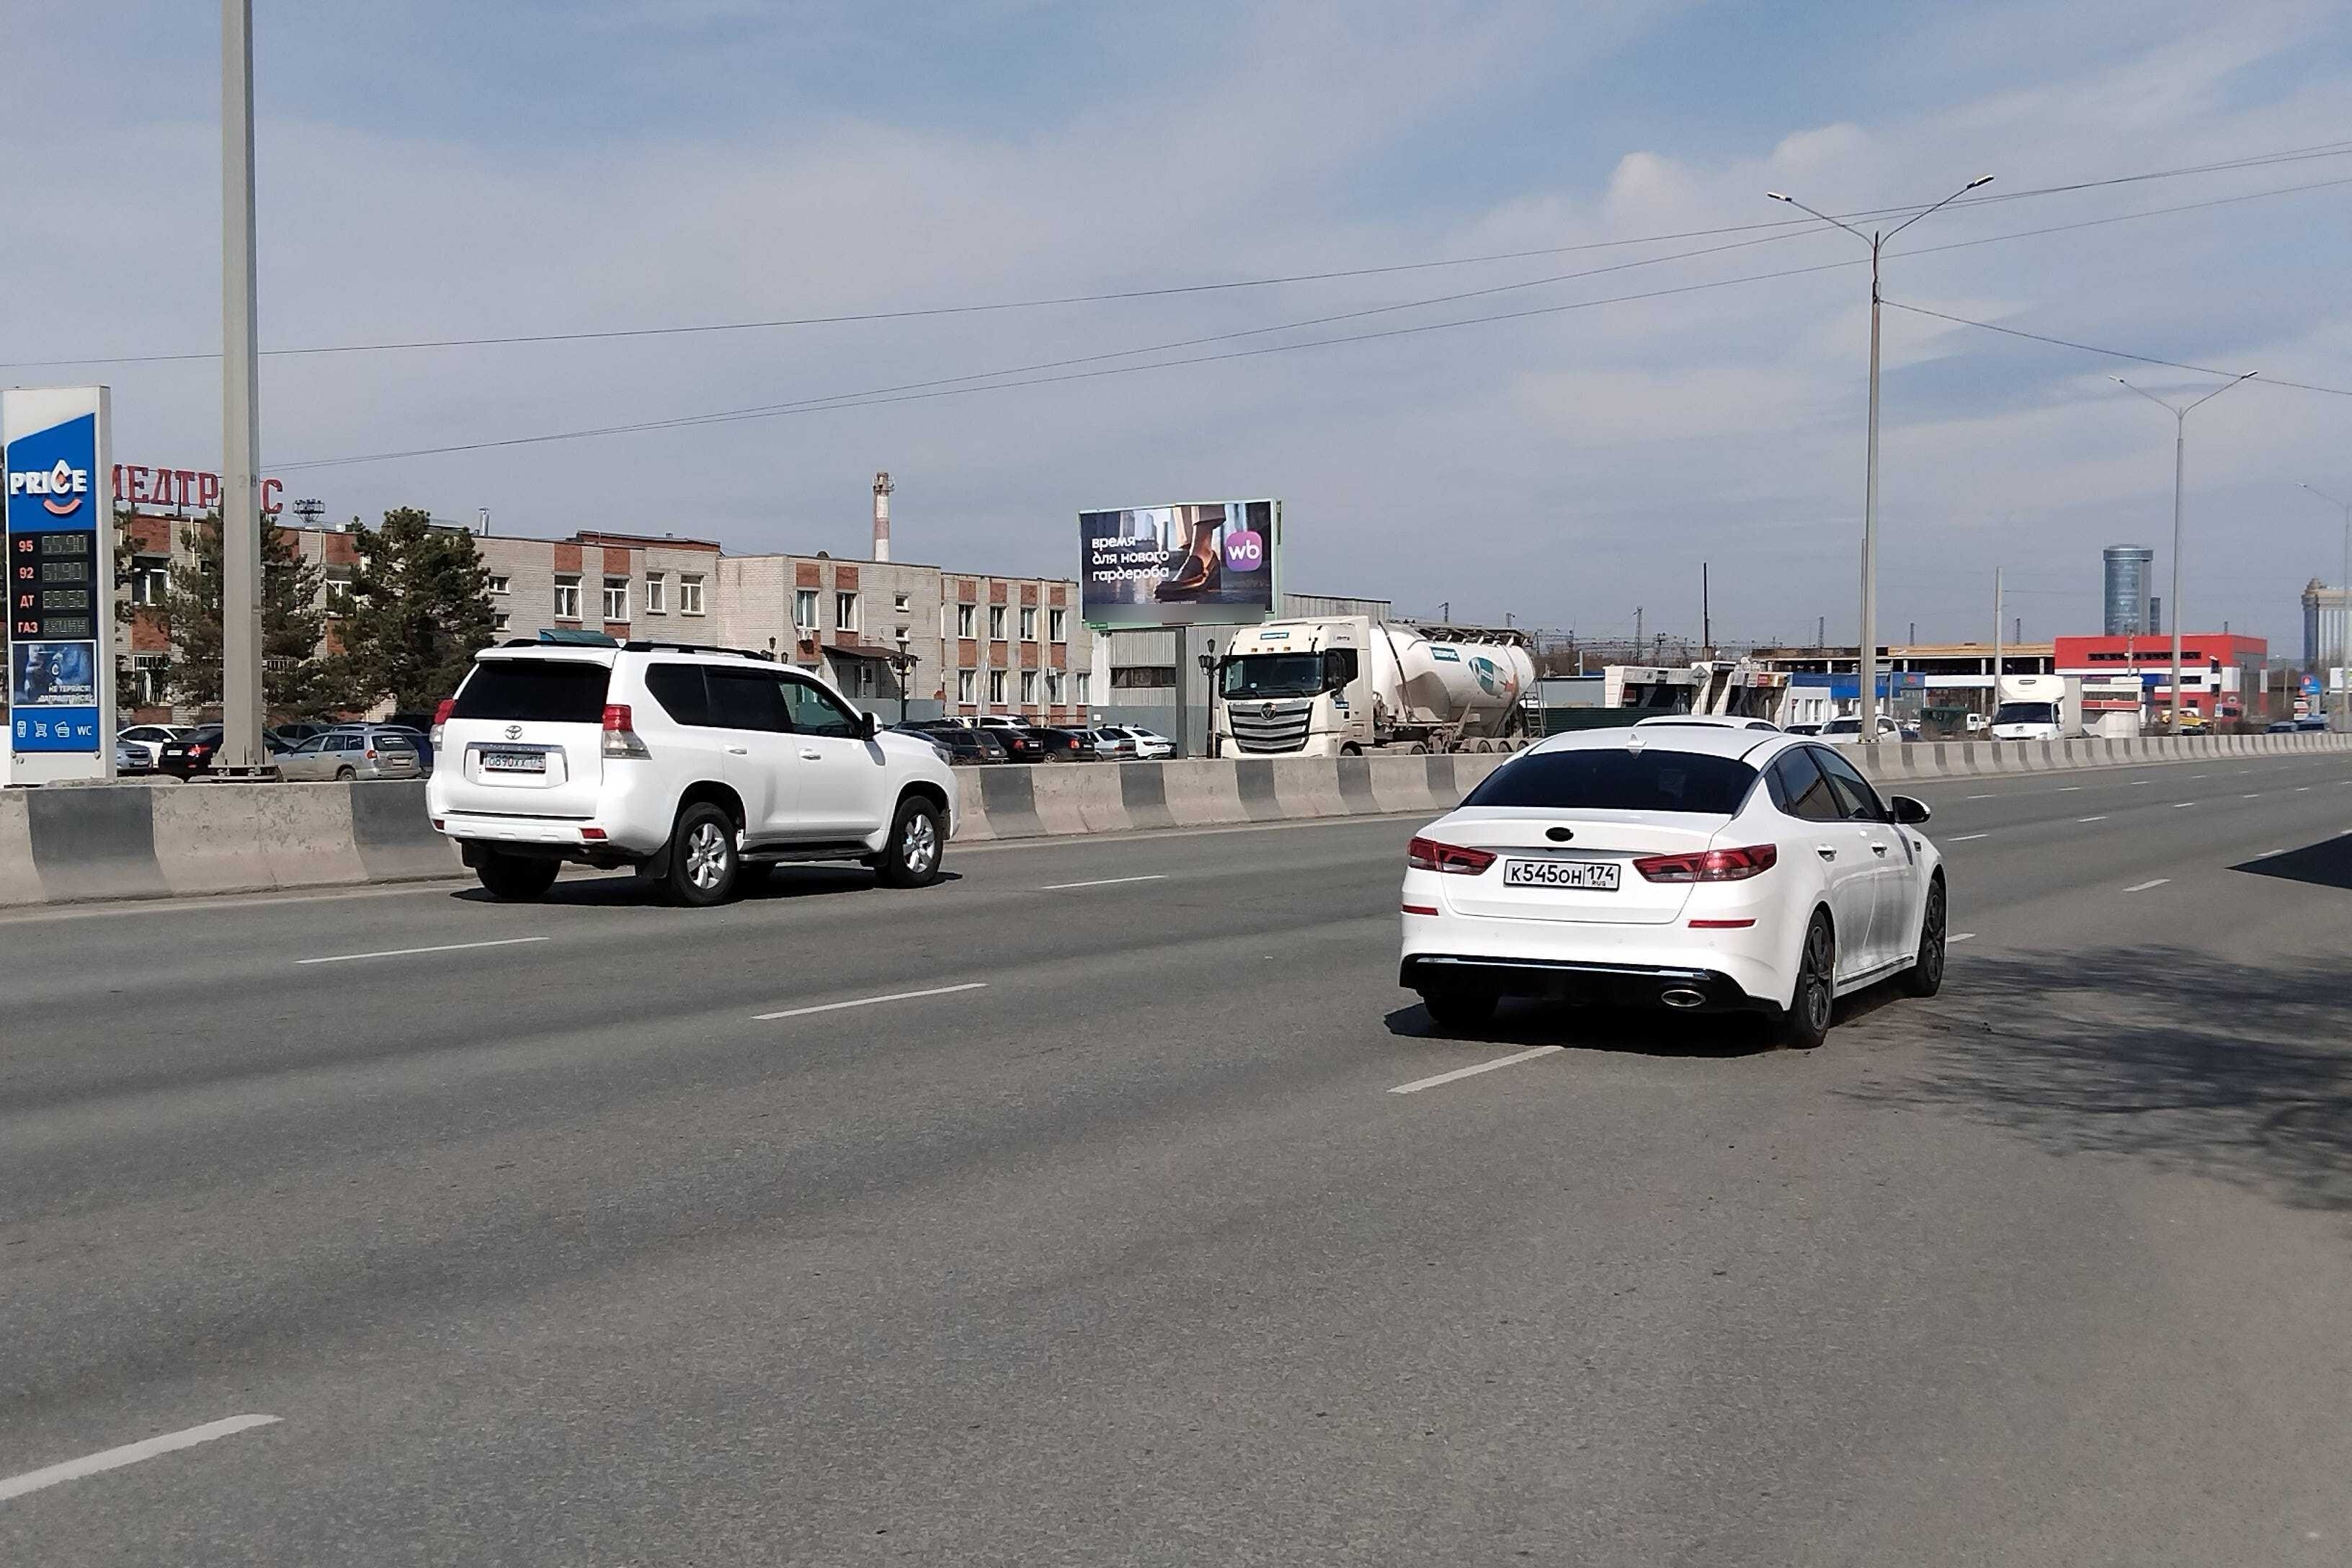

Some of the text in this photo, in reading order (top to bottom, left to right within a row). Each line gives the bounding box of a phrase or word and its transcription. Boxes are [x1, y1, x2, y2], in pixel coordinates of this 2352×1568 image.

[10, 460, 87, 494] PRICE
[19, 540, 34, 553] 95
[1092, 536, 1136, 551] время
[1227, 539, 1260, 561] wb
[1092, 551, 1170, 565] для нового
[19, 567, 35, 579] 92
[1092, 564, 1170, 584] гардероба
[19, 594, 35, 609] ДТ
[18, 621, 38, 634] ГАЗ
[76, 726, 92, 736] WC
[1510, 863, 1615, 885] К545ОН 174
